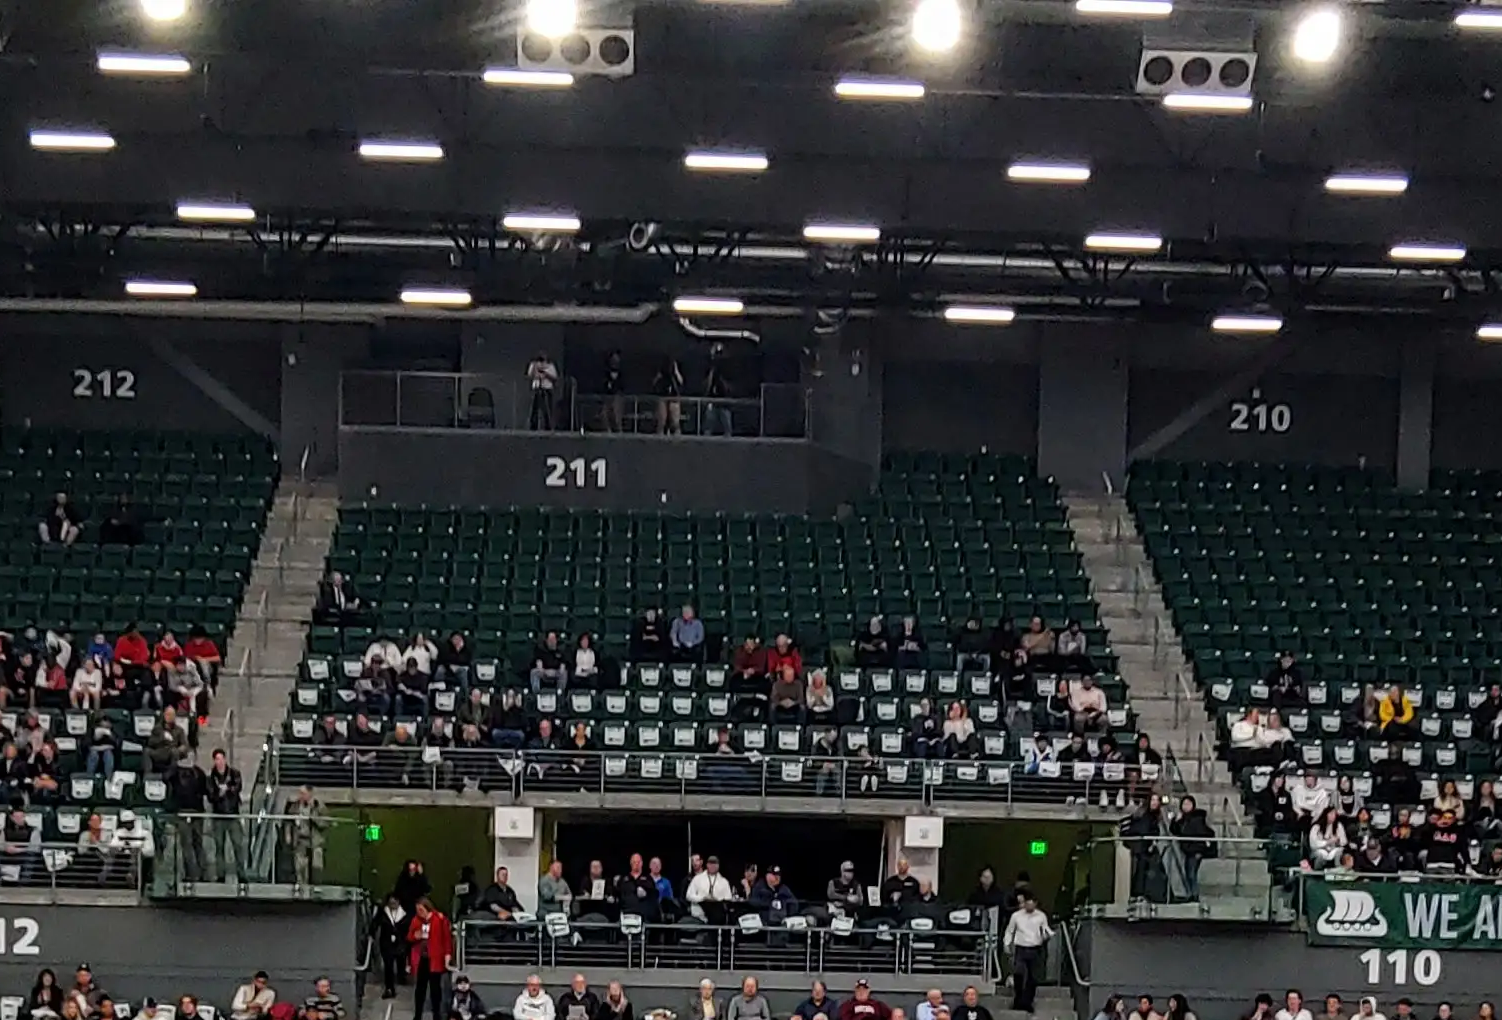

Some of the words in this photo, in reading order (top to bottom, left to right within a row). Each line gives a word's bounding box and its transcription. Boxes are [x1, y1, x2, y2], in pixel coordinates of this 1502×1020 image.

[73, 369, 136, 398] 212
[1230, 403, 1292, 432] 210
[544, 456, 607, 488] 211
[1403, 893, 1459, 940] WE
[1359, 948, 1442, 986] 110
